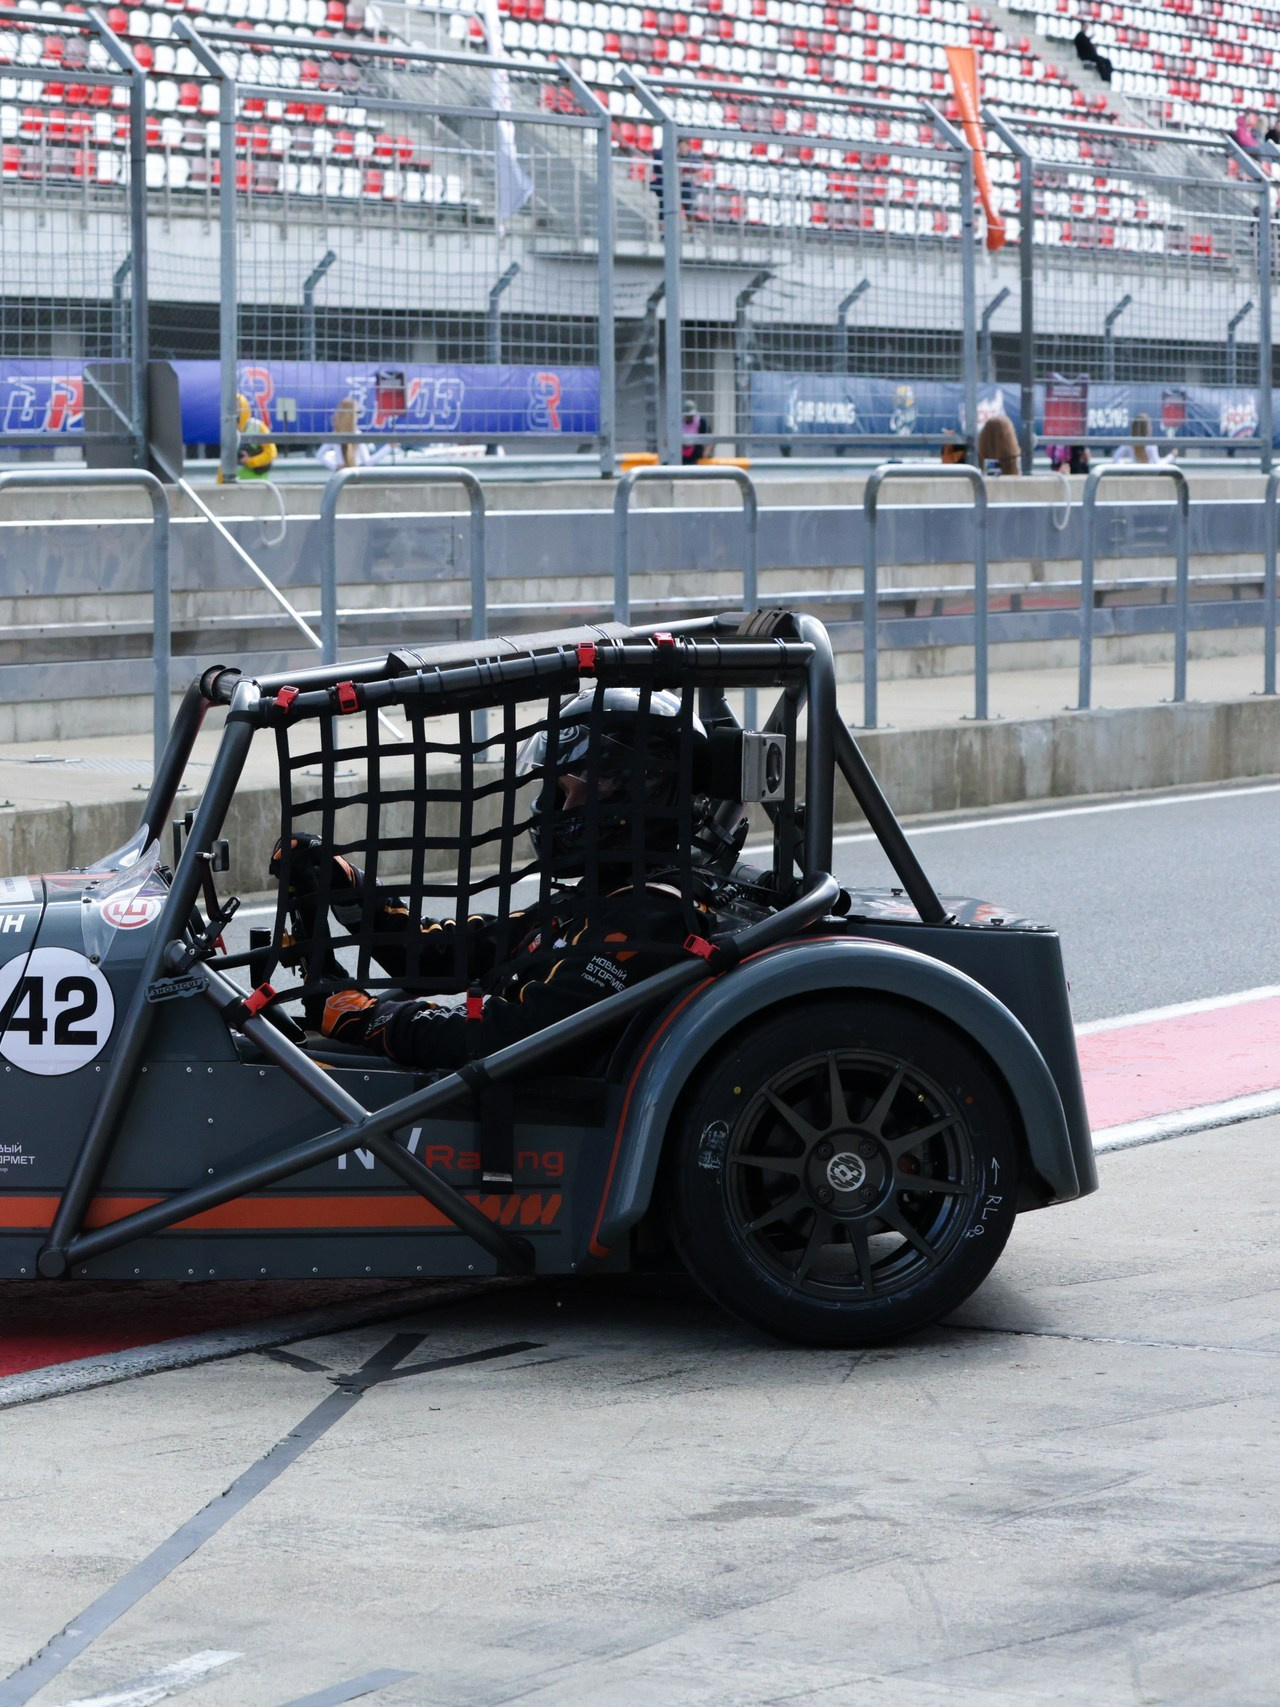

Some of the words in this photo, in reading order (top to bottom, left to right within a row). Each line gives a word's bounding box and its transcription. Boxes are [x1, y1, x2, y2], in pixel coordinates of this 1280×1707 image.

[585, 963, 627, 992] ВТОРМЕ
[591, 955, 628, 980] НОВЫЙ
[0, 975, 99, 1046] 42
[425, 1145, 564, 1177] Rang
